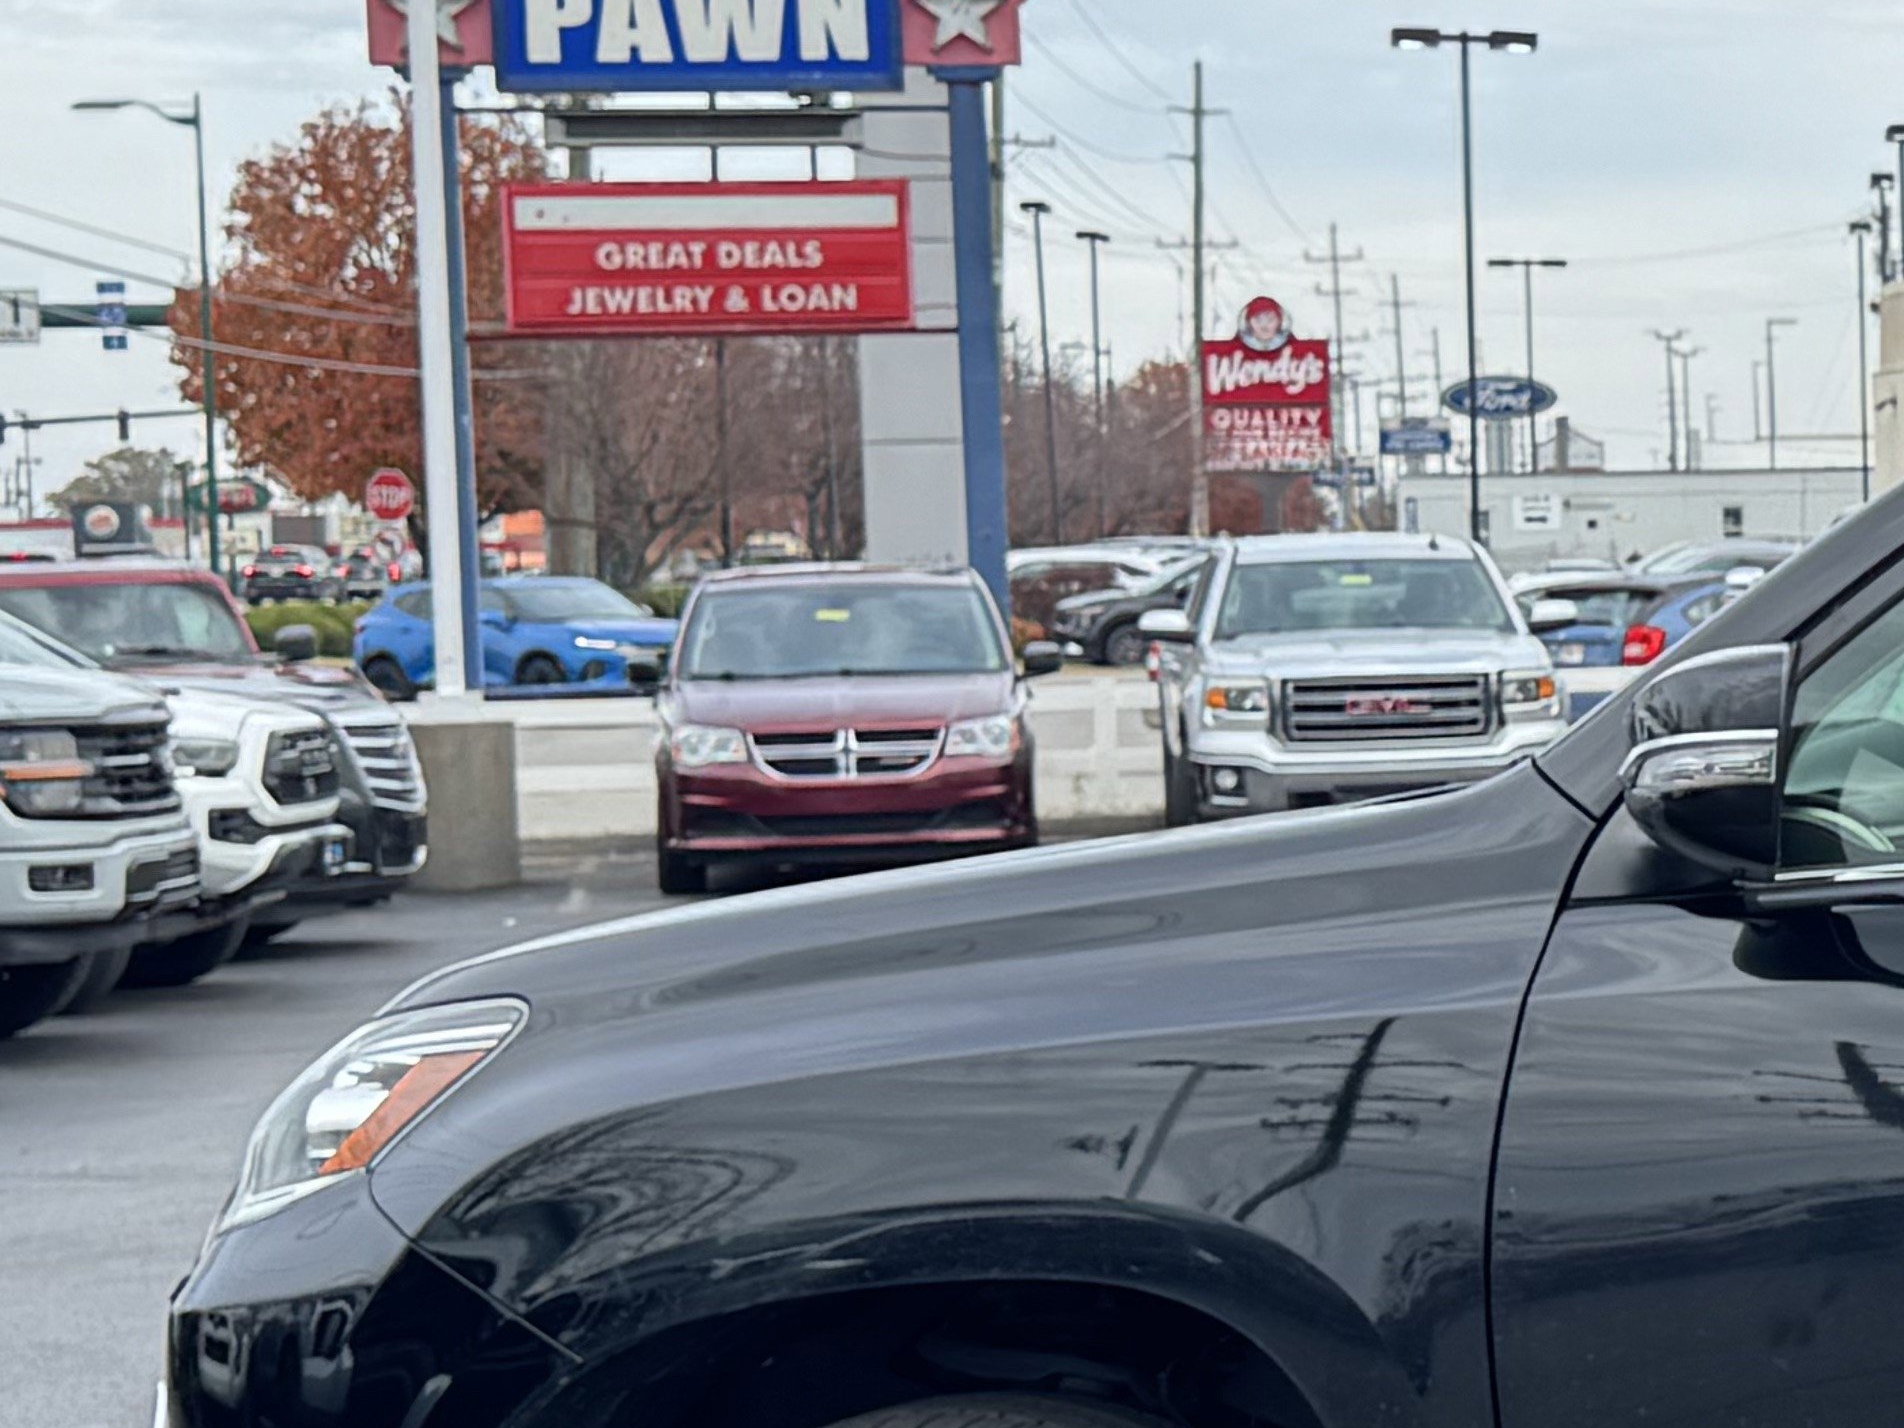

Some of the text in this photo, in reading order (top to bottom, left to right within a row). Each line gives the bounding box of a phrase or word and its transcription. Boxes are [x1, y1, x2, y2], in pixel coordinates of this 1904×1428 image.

[594, 239, 825, 271] GREAT DEALS
[565, 282, 859, 316] JEWELRY & LOAN
[1211, 407, 1322, 430] QUALITY
